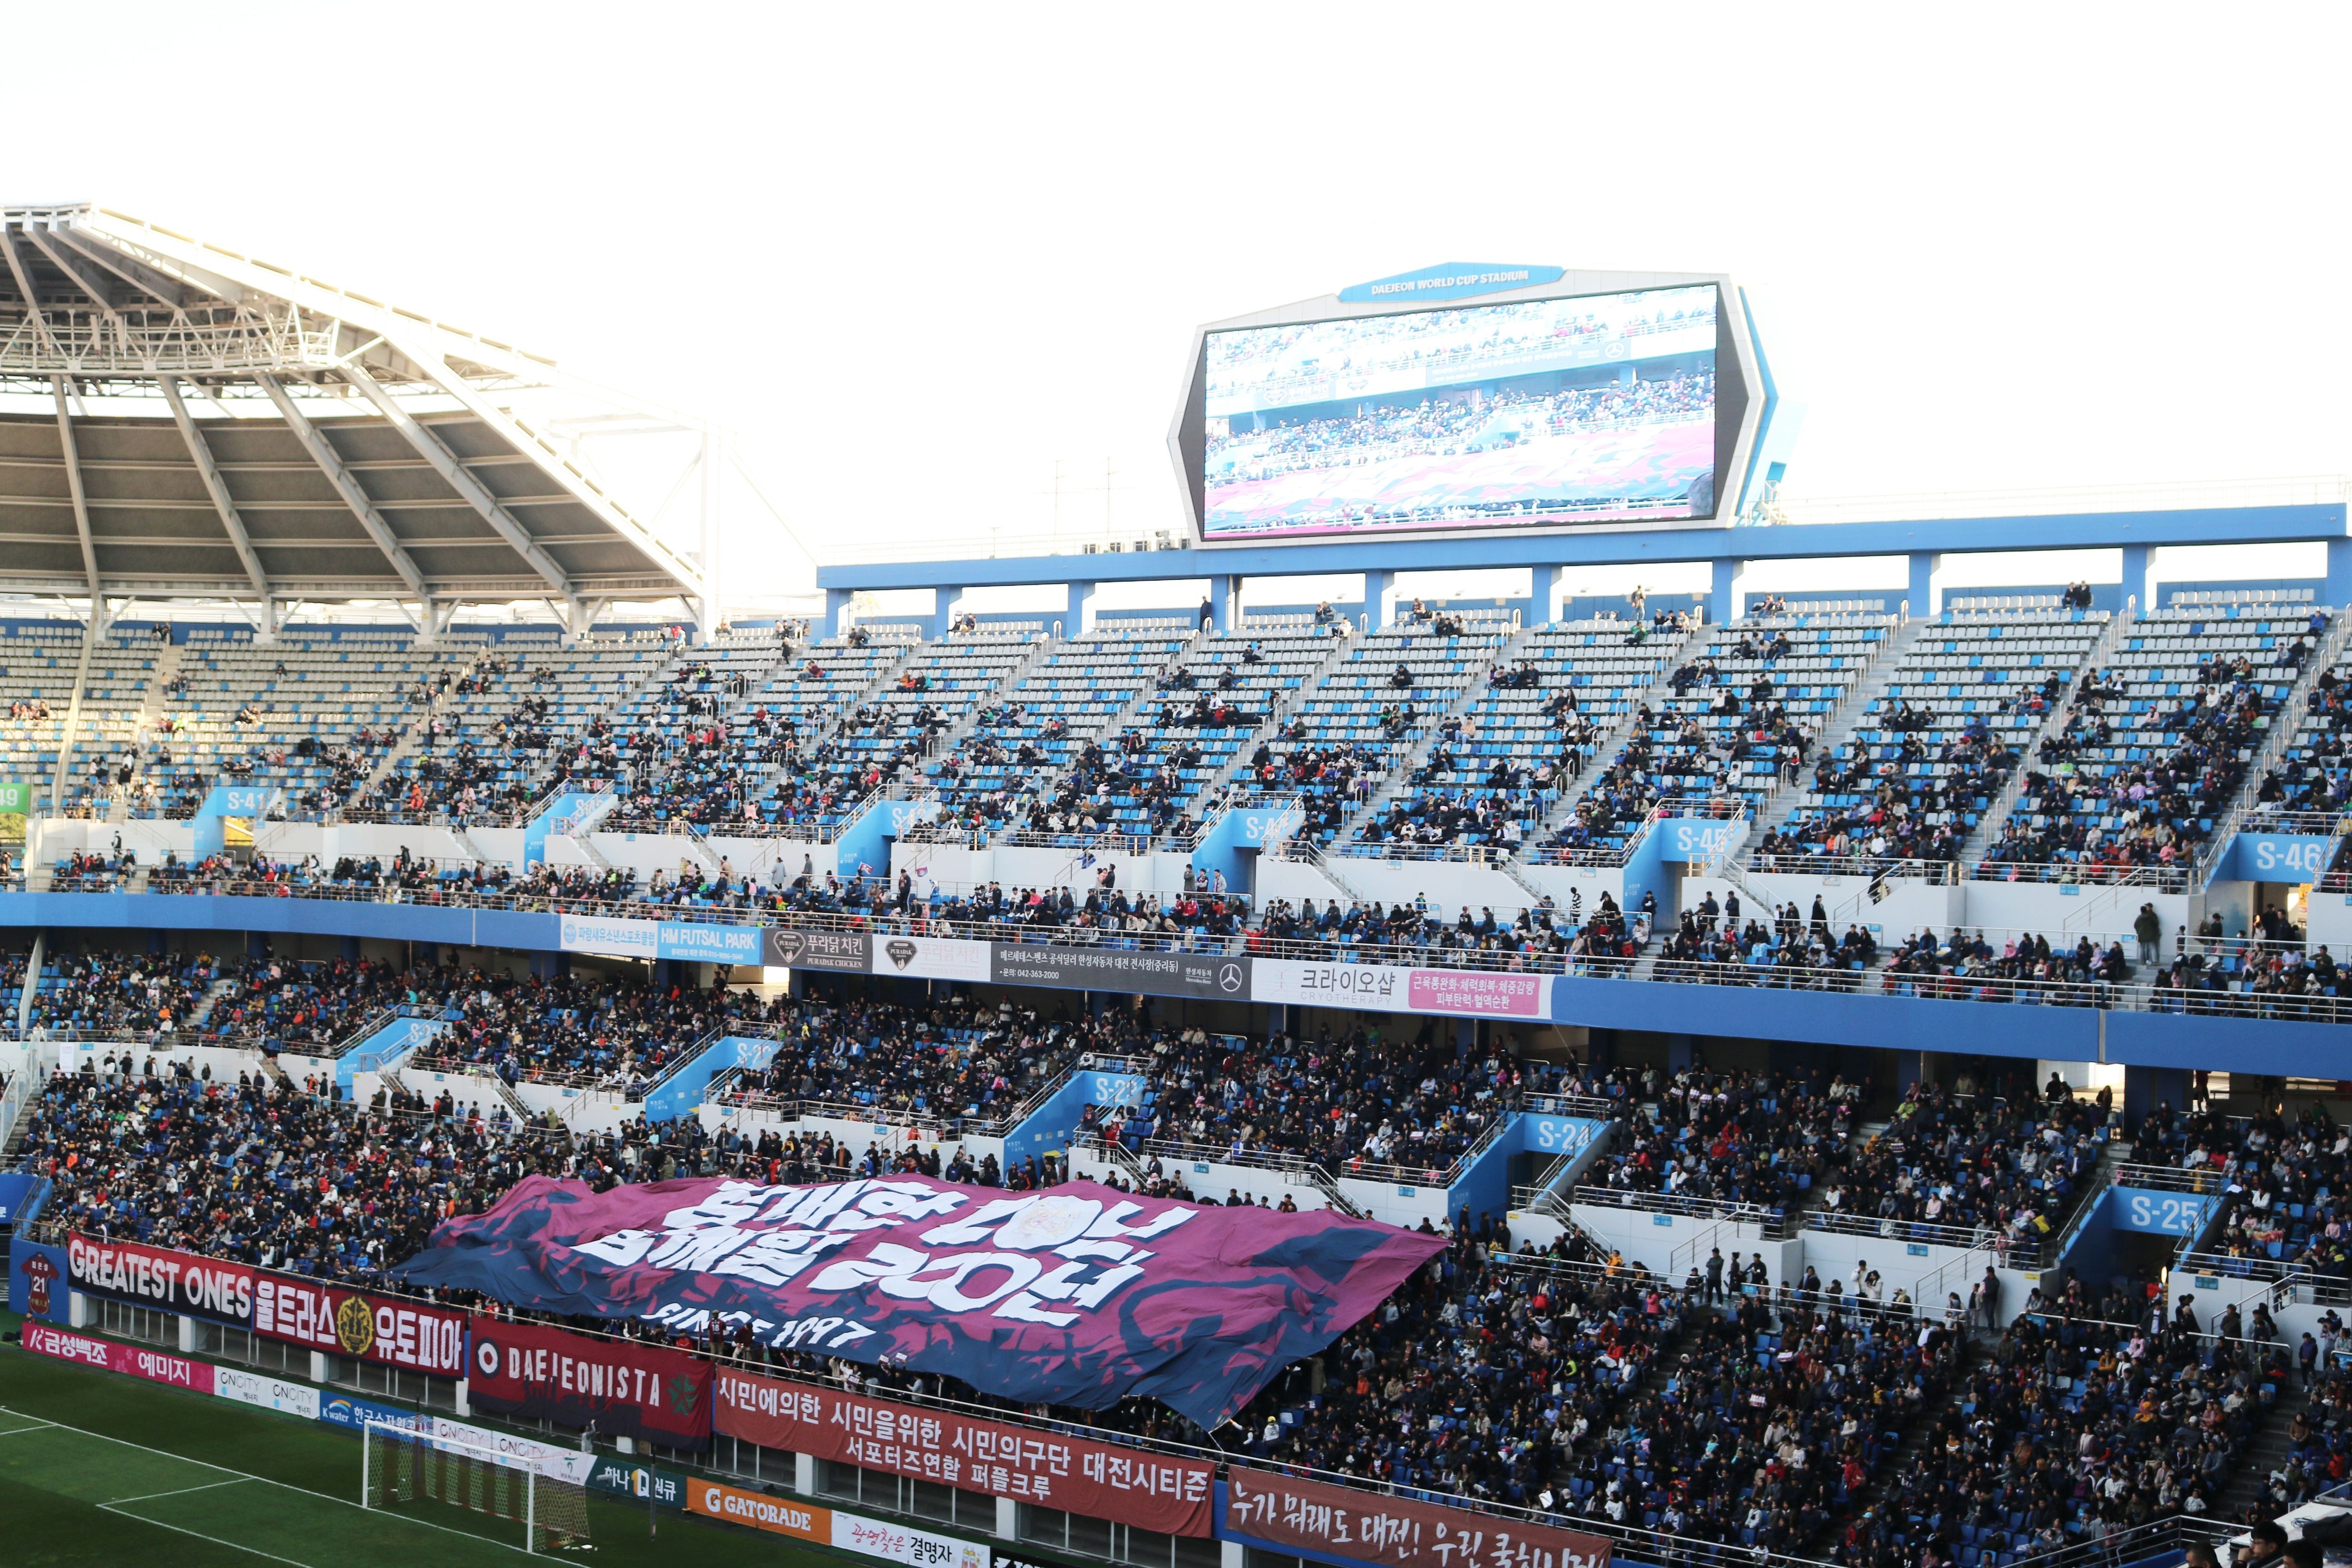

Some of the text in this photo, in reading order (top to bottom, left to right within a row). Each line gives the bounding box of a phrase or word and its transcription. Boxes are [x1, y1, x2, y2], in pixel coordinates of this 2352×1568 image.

[1372, 270, 1529, 295] DAEJEON WORLD CUP STADIUM
[2257, 841, 2321, 873] S-46
[579, 926, 655, 946] 파랑새유소년스포츠클럽
[661, 928, 756, 949] HM FUTSAL PARK
[808, 935, 862, 955] 푸라닭 치킨
[921, 943, 979, 962] 푸라닭 치킨
[1000, 950, 1178, 973] 메르세데스-벤츠 공식딜러 한성자동차 대전 전시장(중리동)
[1018, 970, 1059, 979] 042-363-2000
[1185, 967, 1211, 977] 한성자동차
[1301, 968, 1396, 996] 크라이오샵
[1301, 991, 1391, 1005] CRYOTHERAPY
[2132, 1196, 2200, 1231] S-25
[33, 1276, 45, 1293] 21
[69, 1239, 252, 1318] GREATEST ONES
[256, 1279, 462, 1370] 울트라스 유토피아
[771, 1316, 877, 1348] 1997
[45, 1325, 108, 1366] 금성백조
[138, 1351, 191, 1385] 예미지
[508, 1347, 661, 1407] DAEJEONISTA
[221, 1372, 260, 1391] CNCITY
[273, 1384, 314, 1404] CNCITY
[243, 1392, 259, 1403] 에너지
[329, 1411, 349, 1422] water
[720, 1376, 1208, 1502] 시민에의한 시민을위한 시민의구단 대전시티즌
[604, 1466, 629, 1490] 하나
[846, 1436, 1051, 1500] 서포터즈연합 퍼플크루
[705, 1488, 811, 1532] G GATORADE
[1232, 1481, 1276, 1525] 누가
[1284, 1493, 1354, 1544] 뭐래도
[1361, 1513, 1421, 1560] 대전!
[851, 1523, 952, 1564] 광명찾은 결명자
